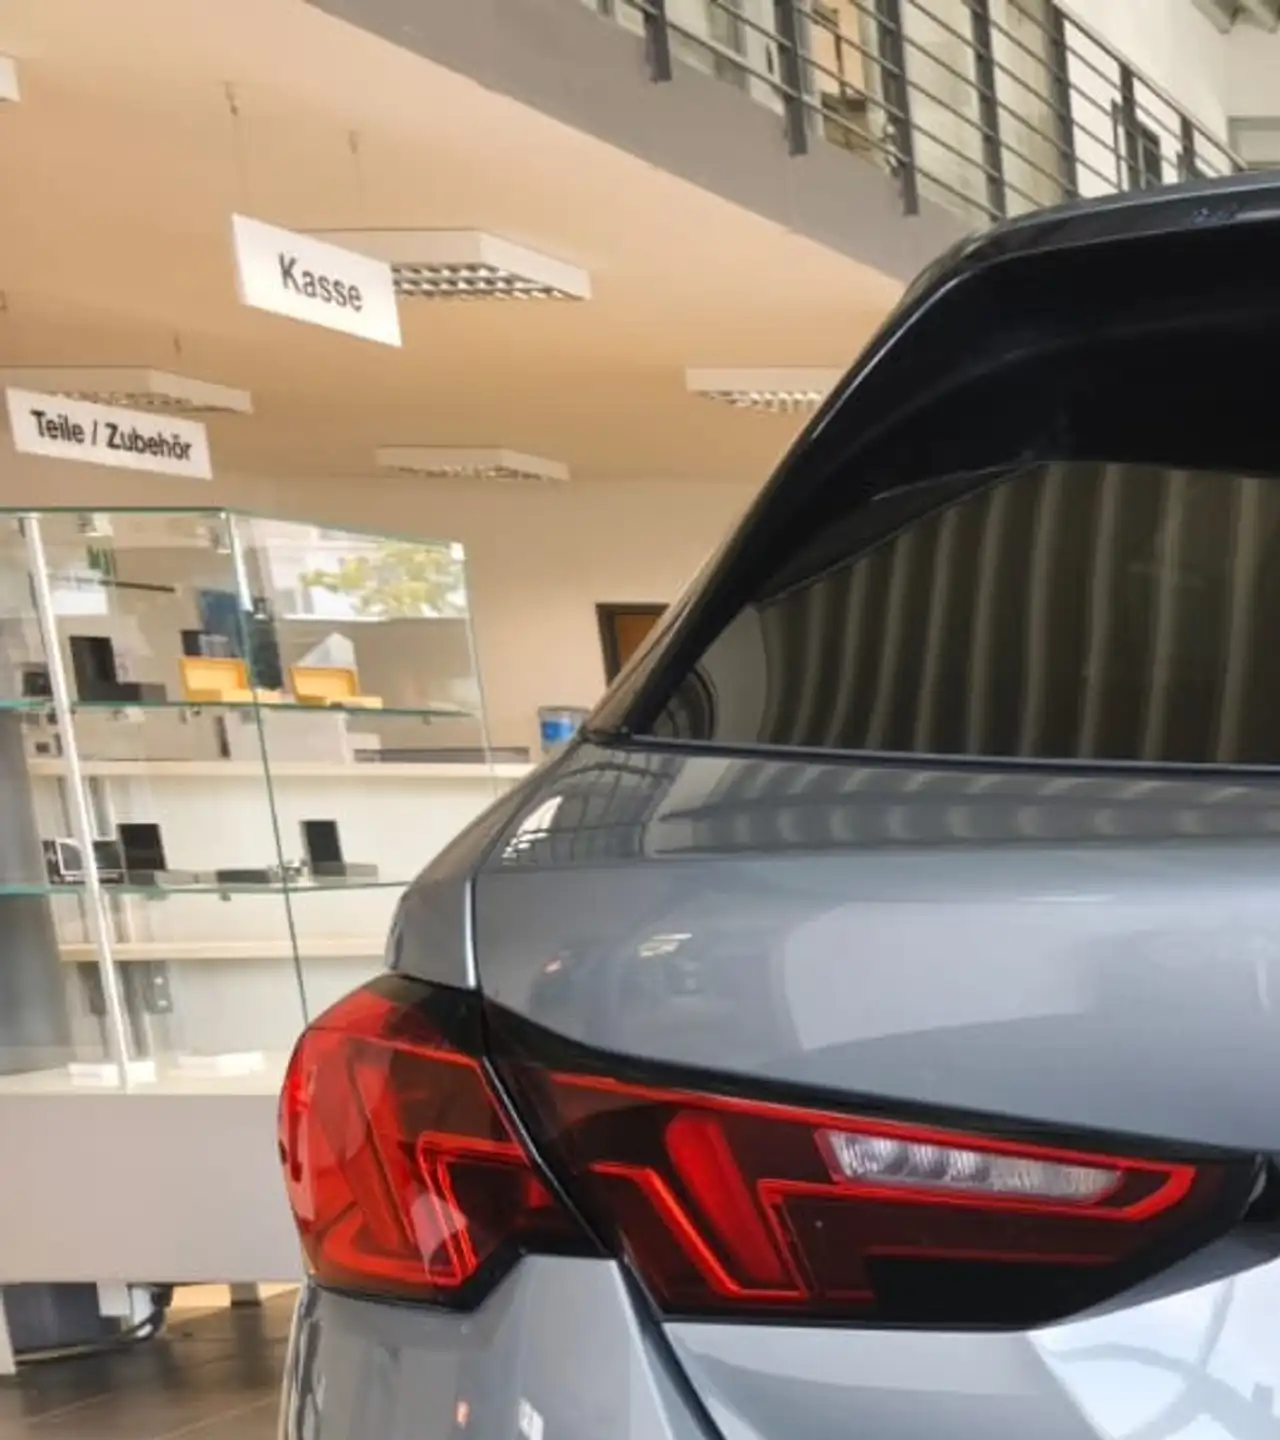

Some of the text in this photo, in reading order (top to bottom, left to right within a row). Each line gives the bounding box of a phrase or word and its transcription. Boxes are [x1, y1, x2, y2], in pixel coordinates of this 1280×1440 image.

[277, 251, 363, 313] Kasse
[30, 408, 192, 461] Teile / Zubehör
